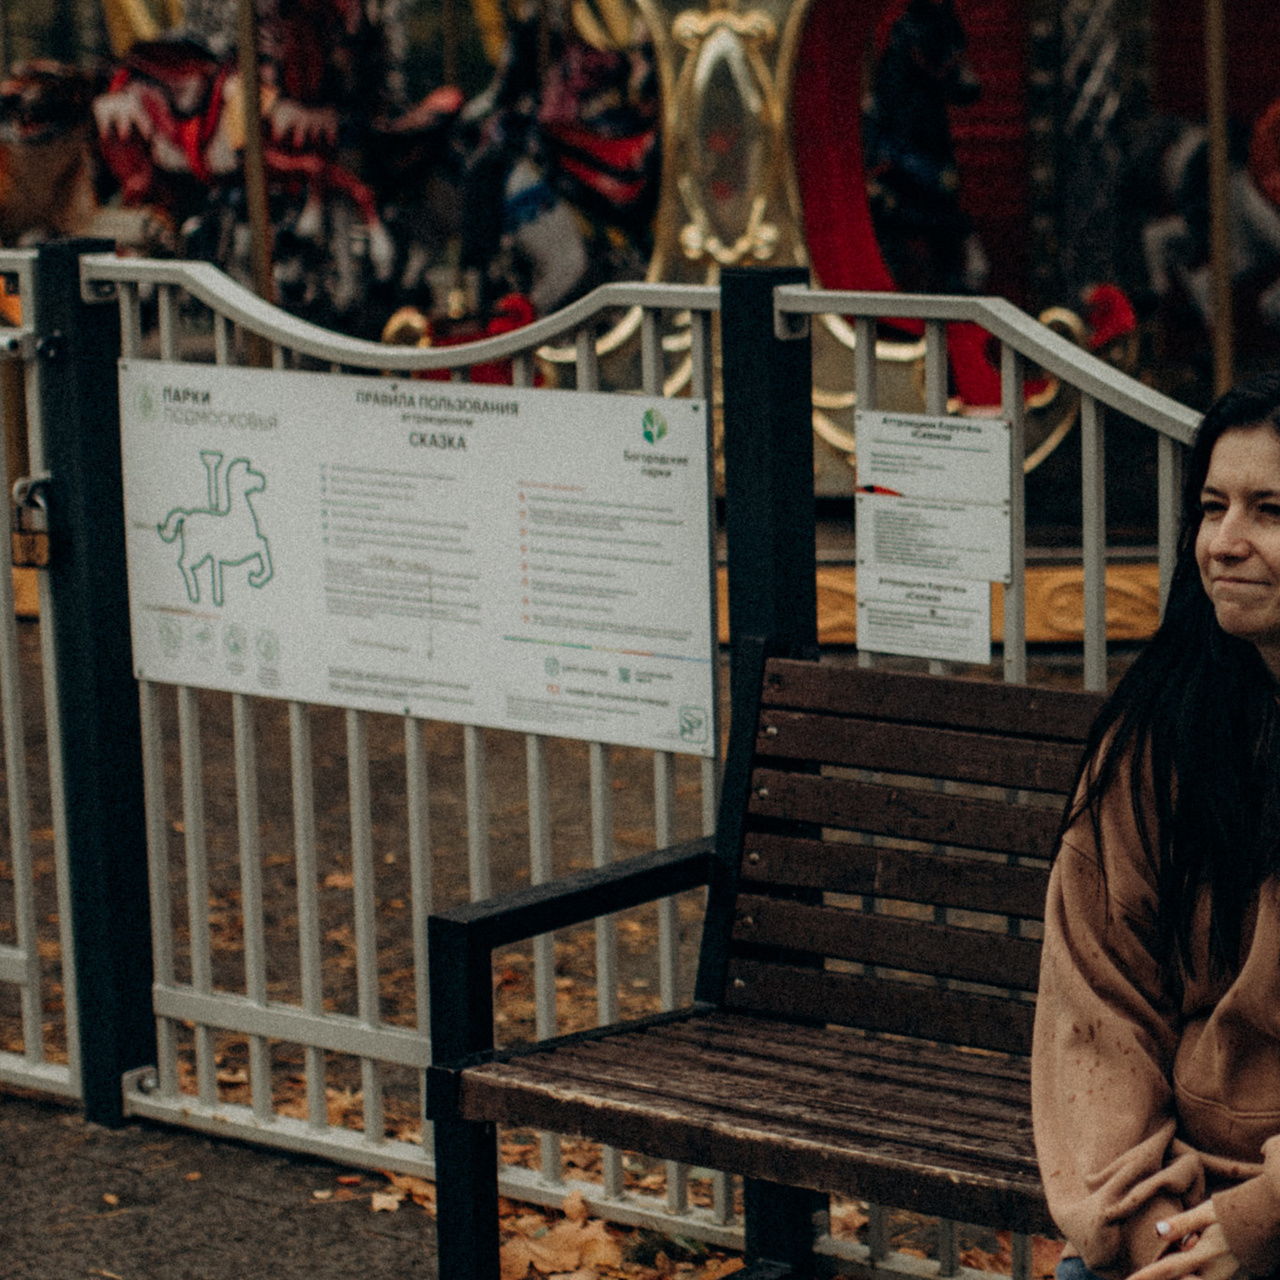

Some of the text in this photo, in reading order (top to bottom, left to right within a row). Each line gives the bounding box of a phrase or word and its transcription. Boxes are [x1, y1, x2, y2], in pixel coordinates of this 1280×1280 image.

[162, 386, 210, 404] ПАРКИ
[356, 390, 519, 415] ПРАВИЛА ПОЛЬЗОВАНИЯ
[408, 431, 466, 450] СКАЗКА
